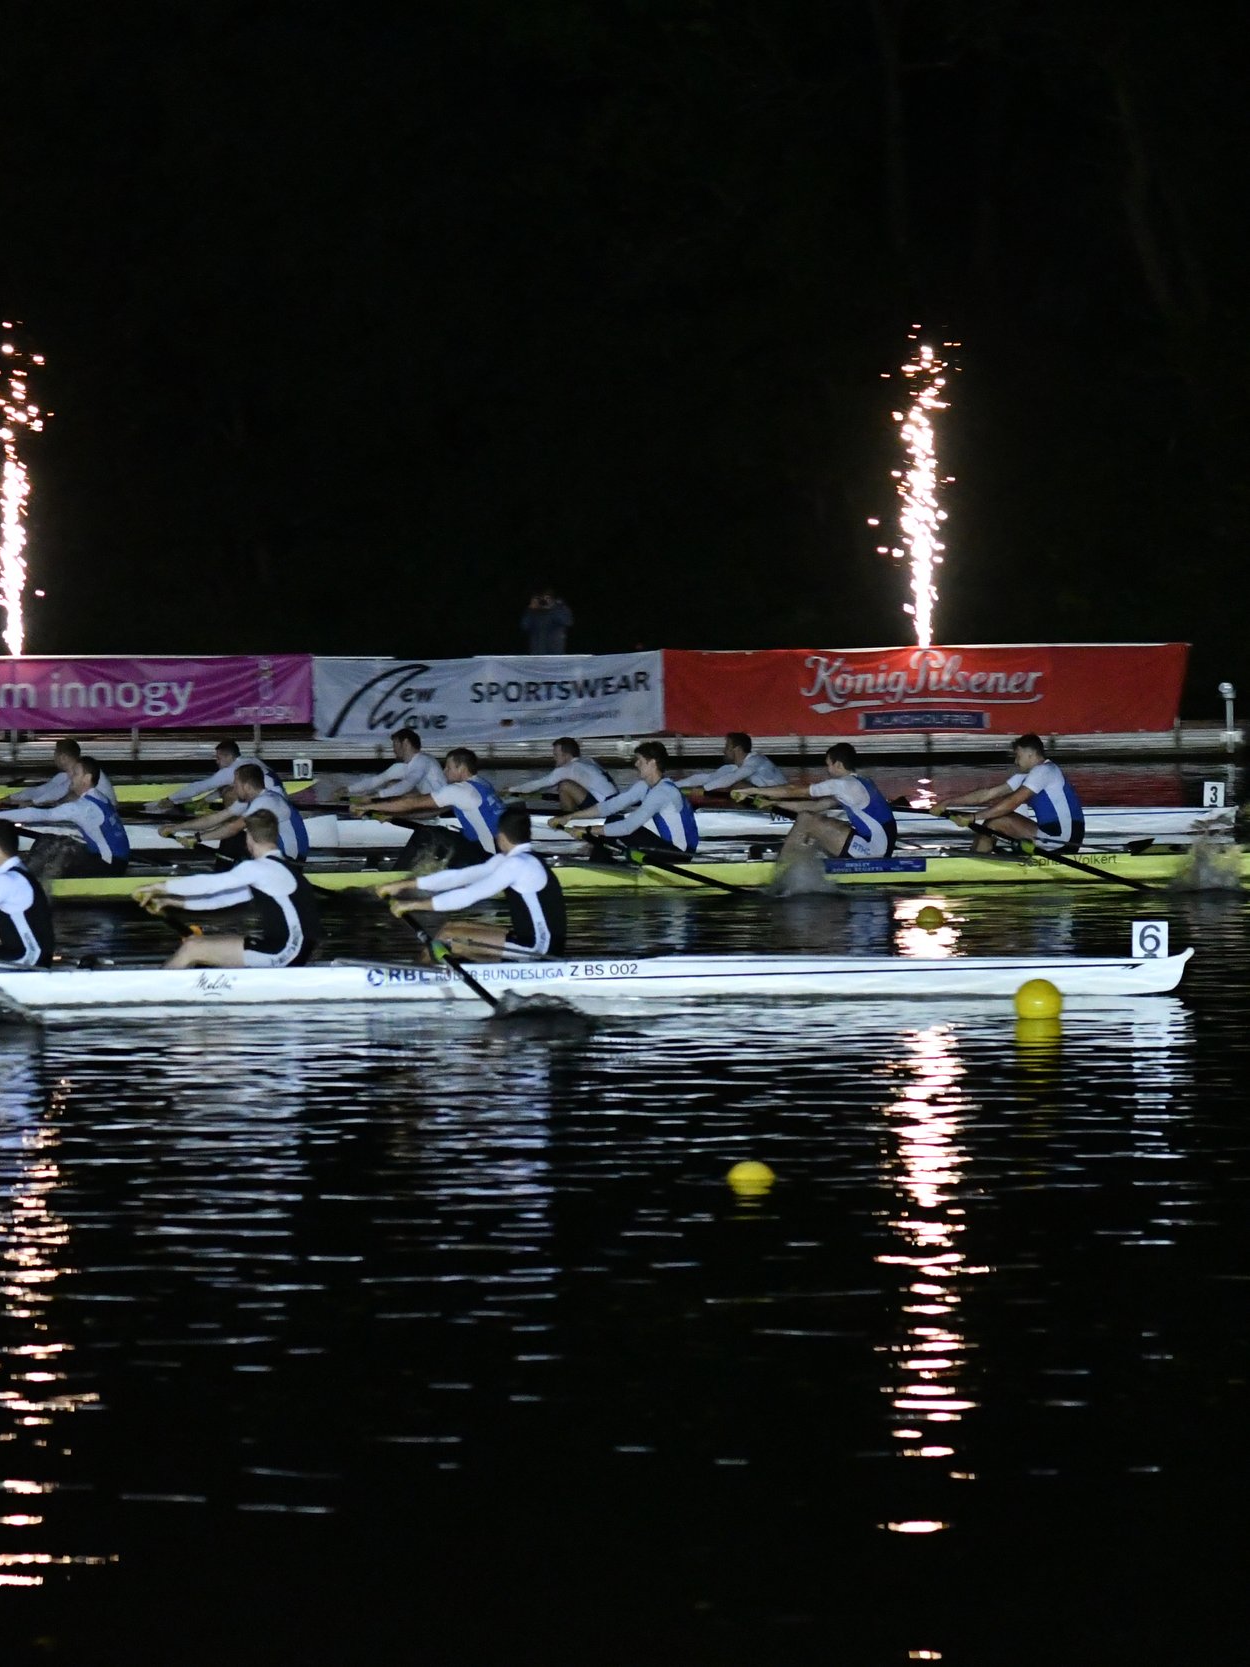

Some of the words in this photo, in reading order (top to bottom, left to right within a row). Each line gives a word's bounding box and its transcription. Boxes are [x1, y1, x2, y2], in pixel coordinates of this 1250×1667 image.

[904, 649, 1044, 693] Pilsener
[51, 672, 194, 717] innogy
[470, 671, 651, 703] SPORTSWEAR
[294, 762, 309, 777] 10
[1210, 785, 1218, 804] 3
[1139, 924, 1161, 953] 6
[389, 968, 430, 982] RBL
[570, 965, 580, 977] Z
[584, 964, 605, 976] BS
[609, 963, 639, 975] 002
